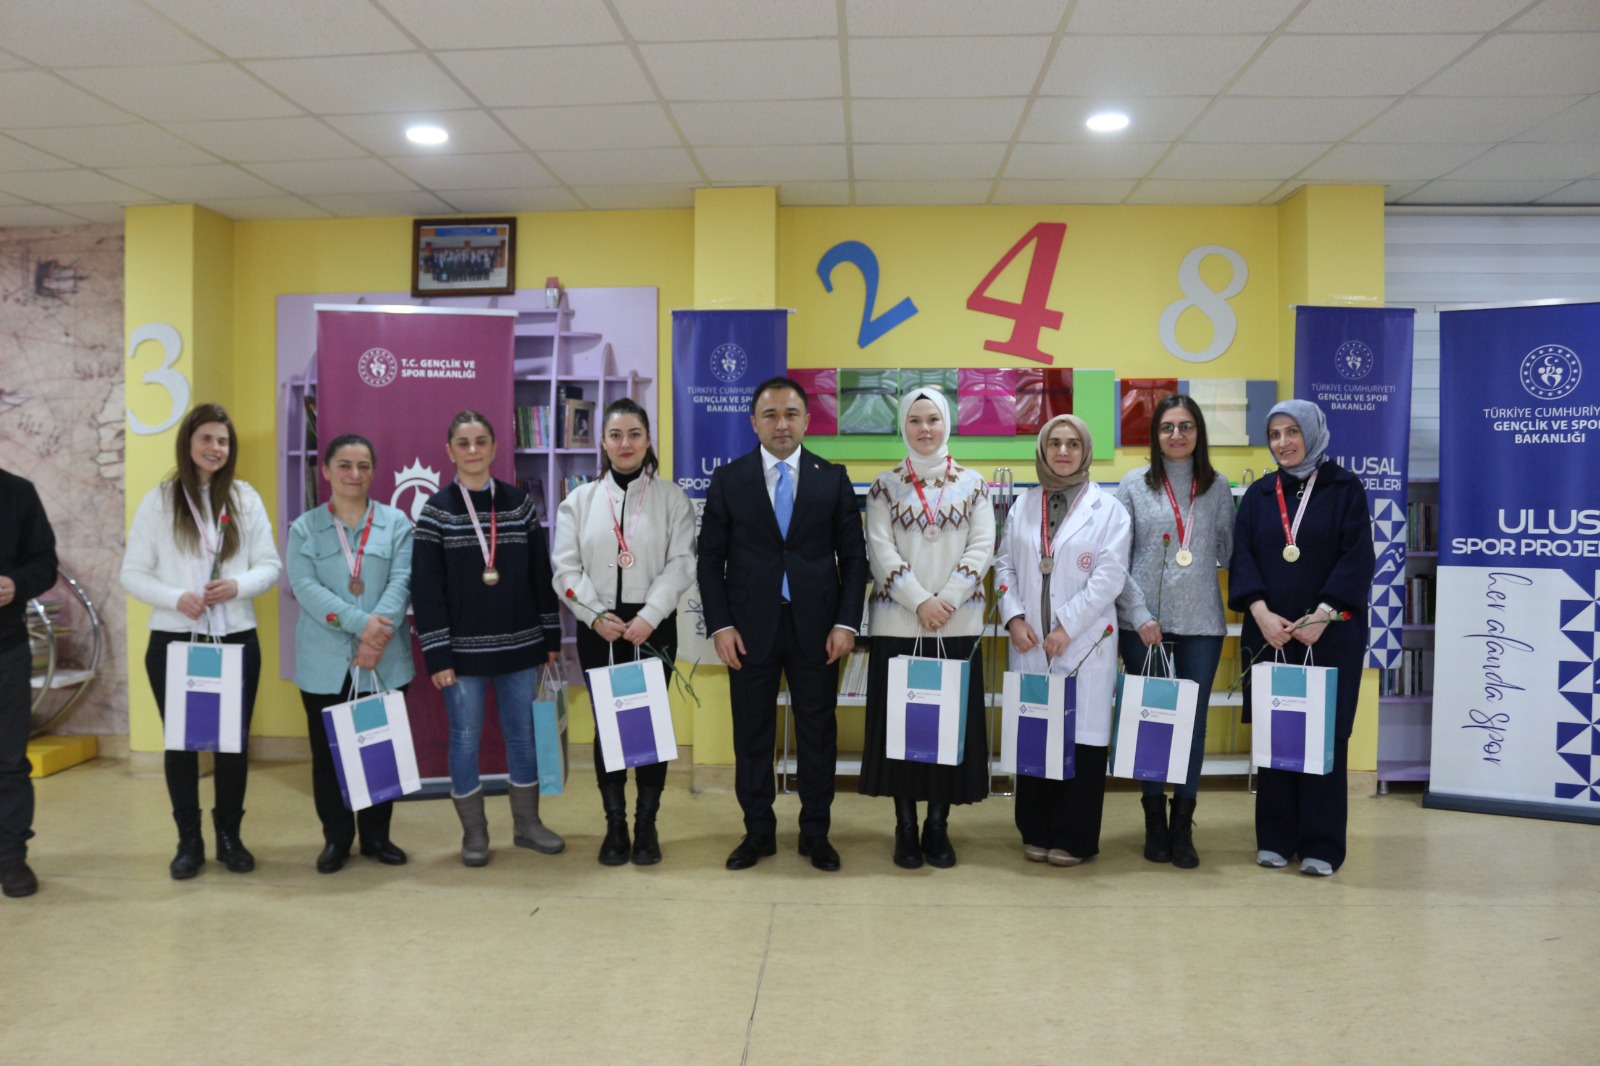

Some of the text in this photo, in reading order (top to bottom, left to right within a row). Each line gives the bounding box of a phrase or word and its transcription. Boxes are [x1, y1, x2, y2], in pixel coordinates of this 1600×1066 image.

[816, 240, 918, 349] 2
[966, 222, 1067, 365] 4
[1158, 244, 1249, 363] 8
[401, 358, 476, 370] T.C. GENÇLİK VE
[127, 322, 191, 436] 3
[401, 369, 476, 379] SPOR BAKANLIĞI
[687, 386, 718, 395] TÜRKİYE
[1311, 383, 1397, 394] TÜRKİYE CUMHURİYETİ
[693, 396, 728, 405] GENÇLİK
[729, 396, 739, 404] VE
[1317, 393, 1388, 403] GENÇLİK VE SPOR
[706, 404, 750, 413] BAKANLIĞI
[1331, 402, 1376, 411] BAKANLIĞI
[1483, 406, 1532, 419] TÜRKİYE
[1493, 418, 1600, 433] GENÇLİK VE SPO
[1514, 430, 1586, 444] BAKANLIĞI
[1498, 508, 1600, 535] ULUS
[1451, 537, 1600, 557] SPOR PROJE
[1486, 572, 1533, 613] her
